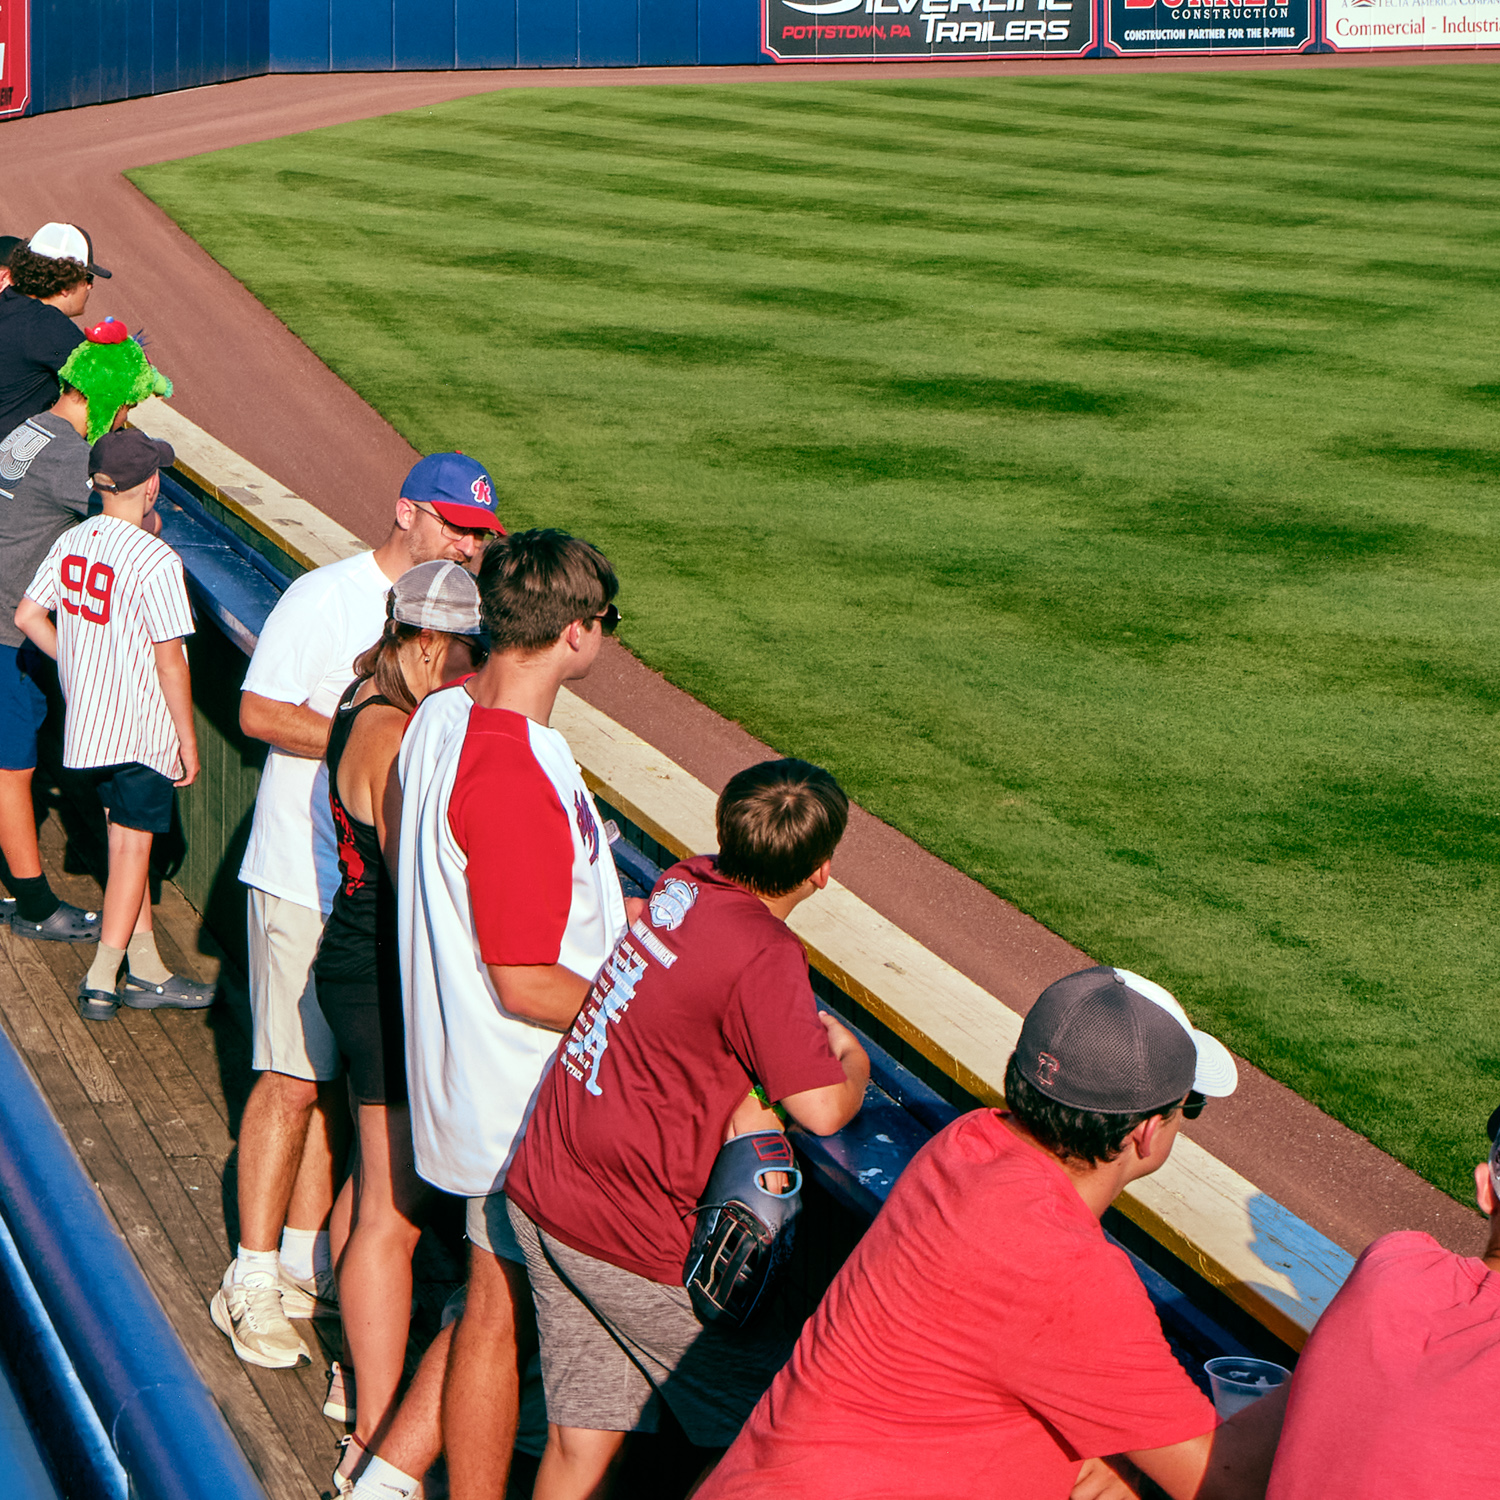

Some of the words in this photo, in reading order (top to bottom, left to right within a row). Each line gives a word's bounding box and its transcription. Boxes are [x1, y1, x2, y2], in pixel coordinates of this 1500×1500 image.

[1171, 7, 1289, 20] CONSTRUCTION
[782, 25, 887, 40] POTTSTOWN,
[890, 25, 911, 39] PA
[920, 12, 1069, 42] TRAILERS
[1124, 28, 1185, 41] CONSTRUCTION
[1189, 27, 1225, 40] PARTNER
[1228, 27, 1245, 39] FOR
[1264, 26, 1295, 39] R-PHILS
[1335, 17, 1425, 36] Commercial
[60, 553, 115, 625] 99
